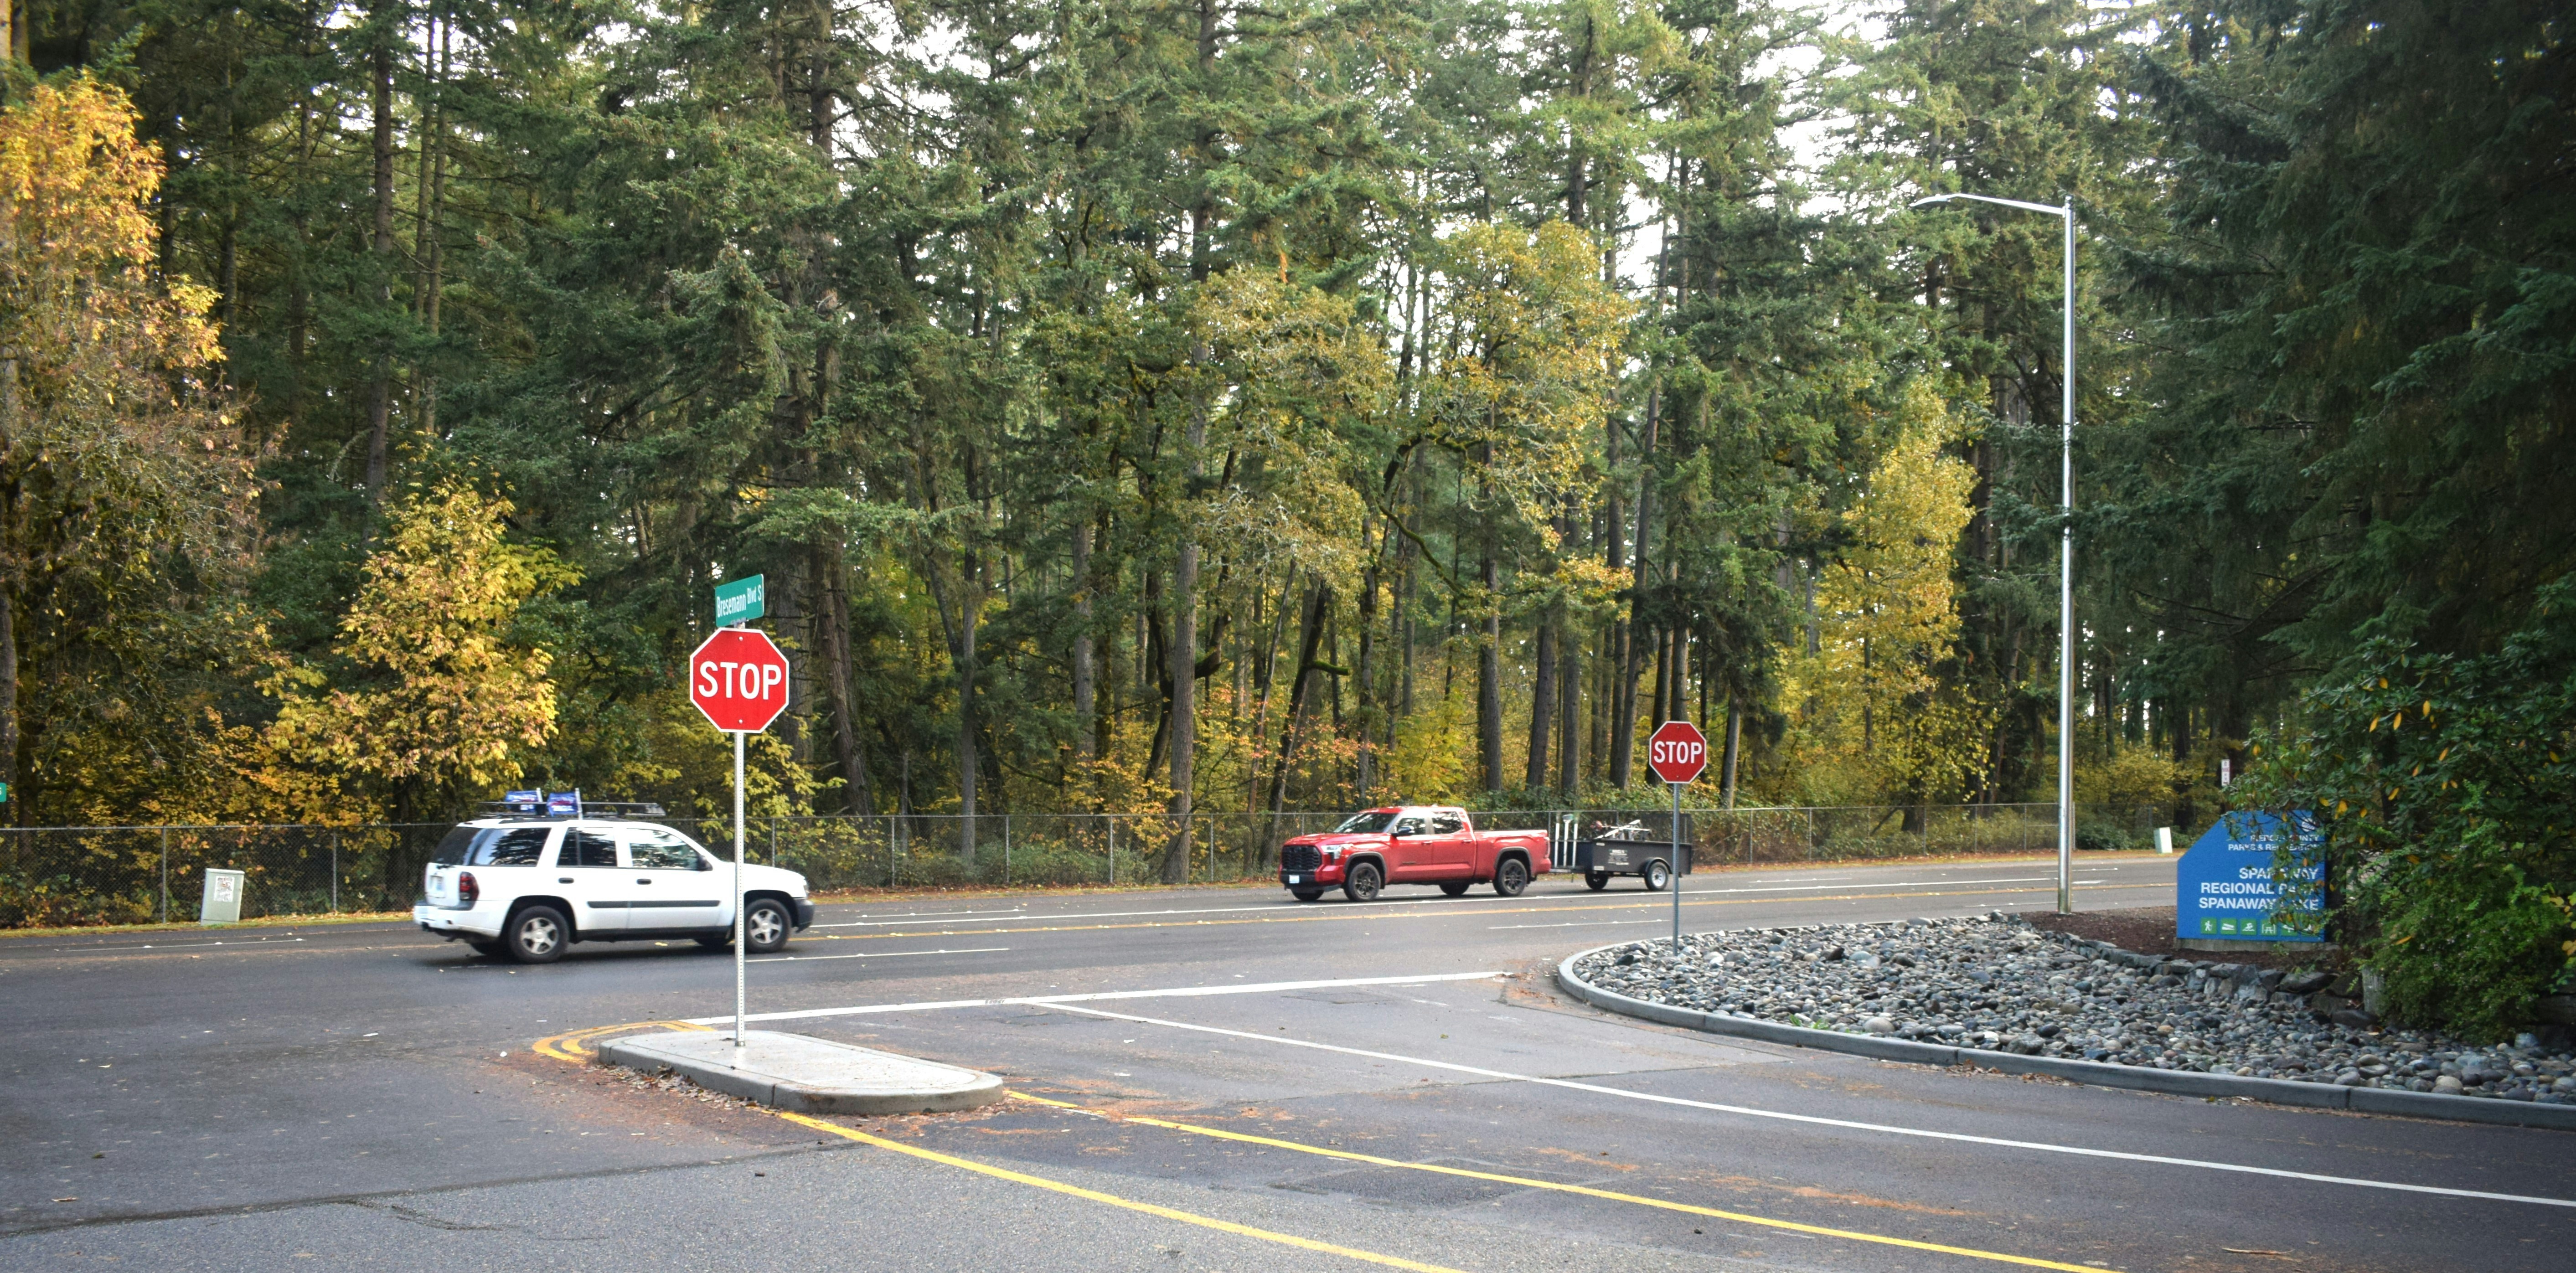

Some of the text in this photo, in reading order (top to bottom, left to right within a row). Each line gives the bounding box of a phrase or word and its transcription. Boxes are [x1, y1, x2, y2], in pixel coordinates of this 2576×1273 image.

[717, 584, 762, 618] Bresemann Blvd S
[698, 661, 782, 700] STOP
[1653, 741, 1702, 764] STOP
[2201, 882, 2275, 894] REGIONAL
[2199, 897, 2276, 909] SPANAWAY
